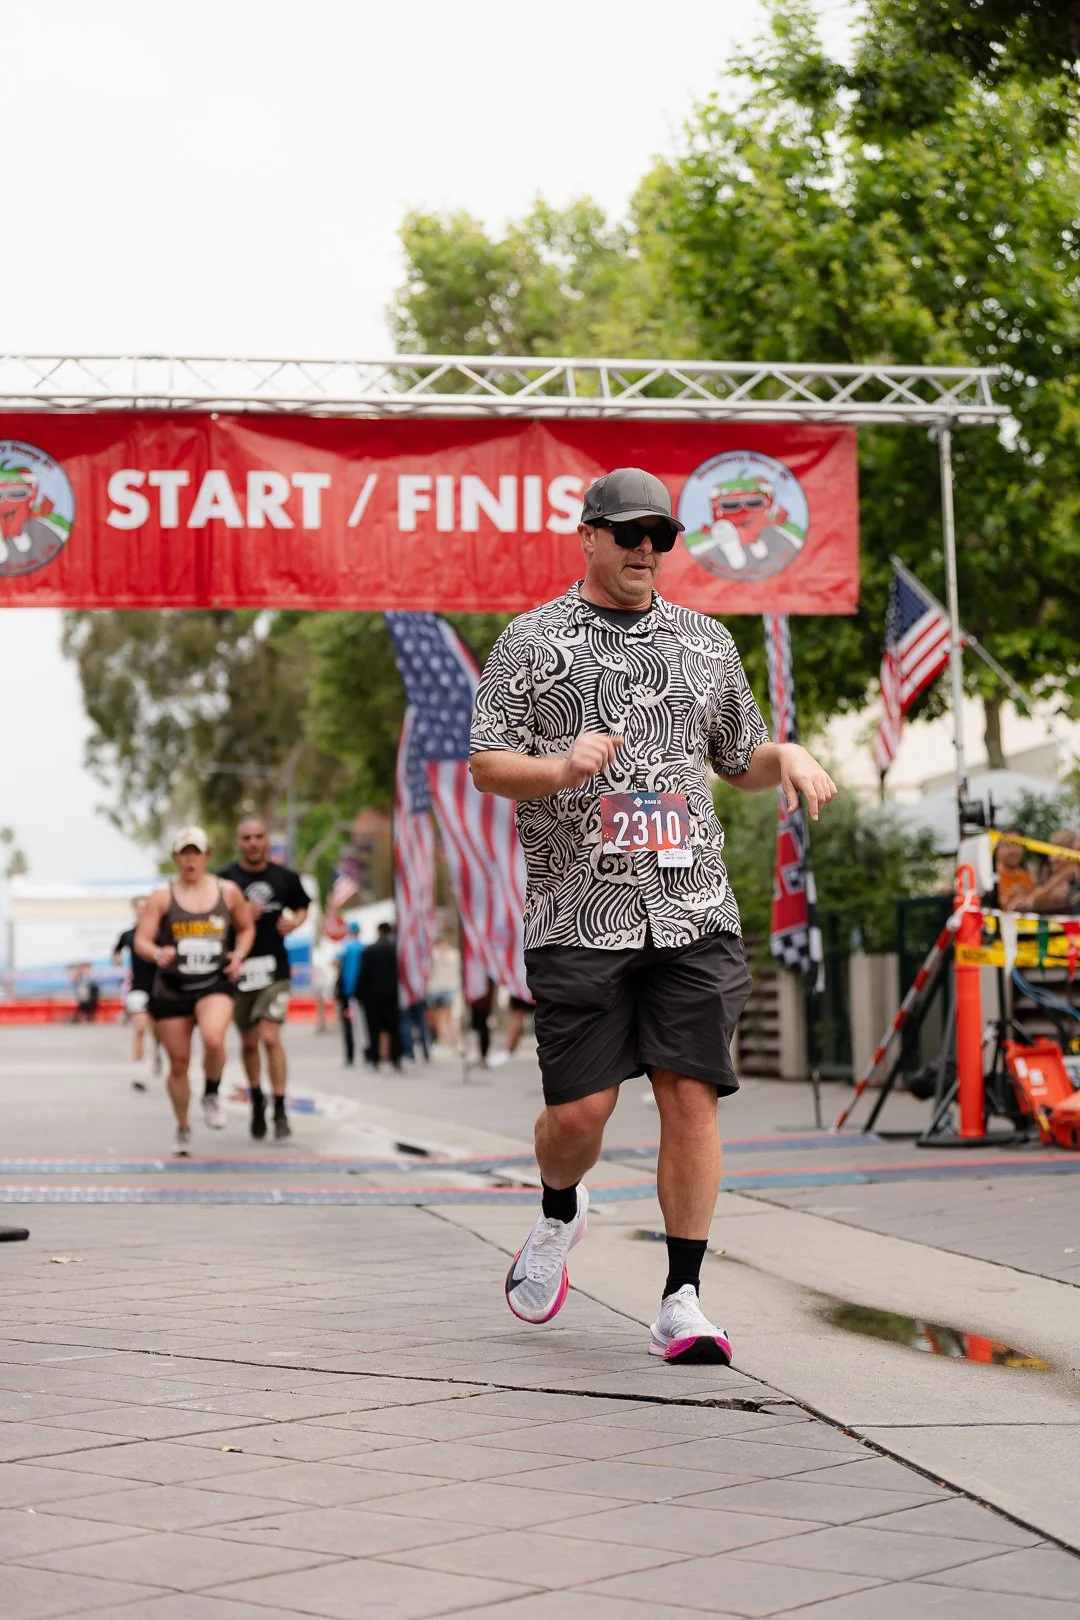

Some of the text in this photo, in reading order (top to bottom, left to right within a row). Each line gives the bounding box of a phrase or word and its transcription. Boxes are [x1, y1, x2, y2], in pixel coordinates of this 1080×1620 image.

[107, 469, 599, 535] START / FINIS
[613, 810, 682, 847] 2310
